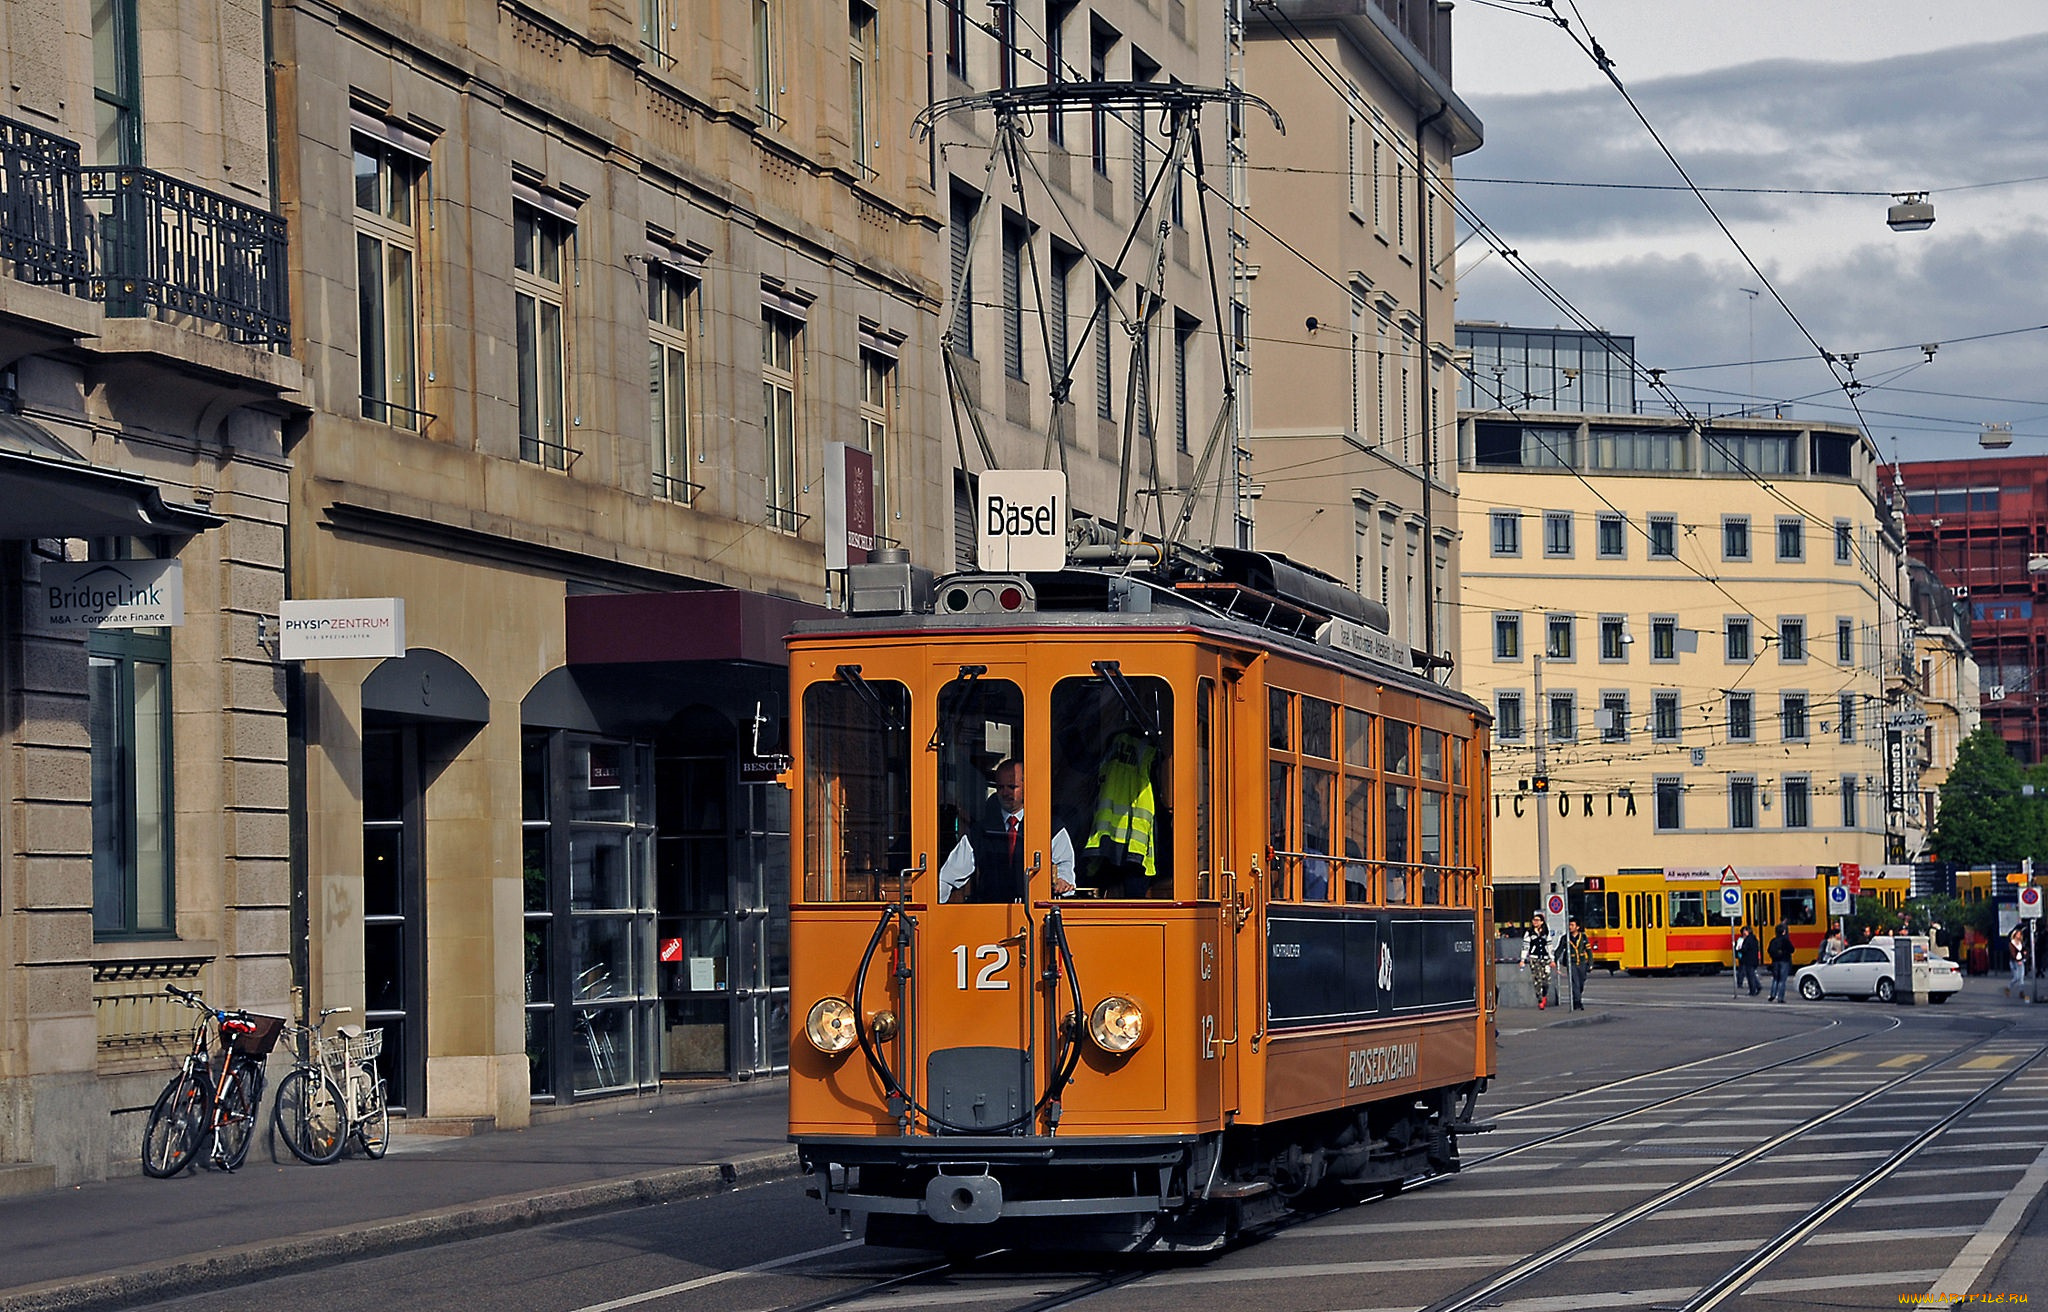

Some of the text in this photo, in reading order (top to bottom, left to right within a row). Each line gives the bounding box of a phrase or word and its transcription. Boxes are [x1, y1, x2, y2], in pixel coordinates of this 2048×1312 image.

[987, 495, 1056, 536] Basel
[49, 584, 161, 613] BridgeLink
[50, 615, 71, 625] M&A
[81, 611, 127, 626] Corporate
[130, 611, 165, 622] Finance
[1991, 687, 2003, 699] K
[1820, 720, 1830, 732] K
[1693, 749, 1704, 761] 15
[1589, 878, 1600, 890] 11
[951, 944, 1009, 991] 12
[1202, 1015, 1214, 1059] 12
[1348, 1042, 1418, 1089] BIRSECKBAHN
